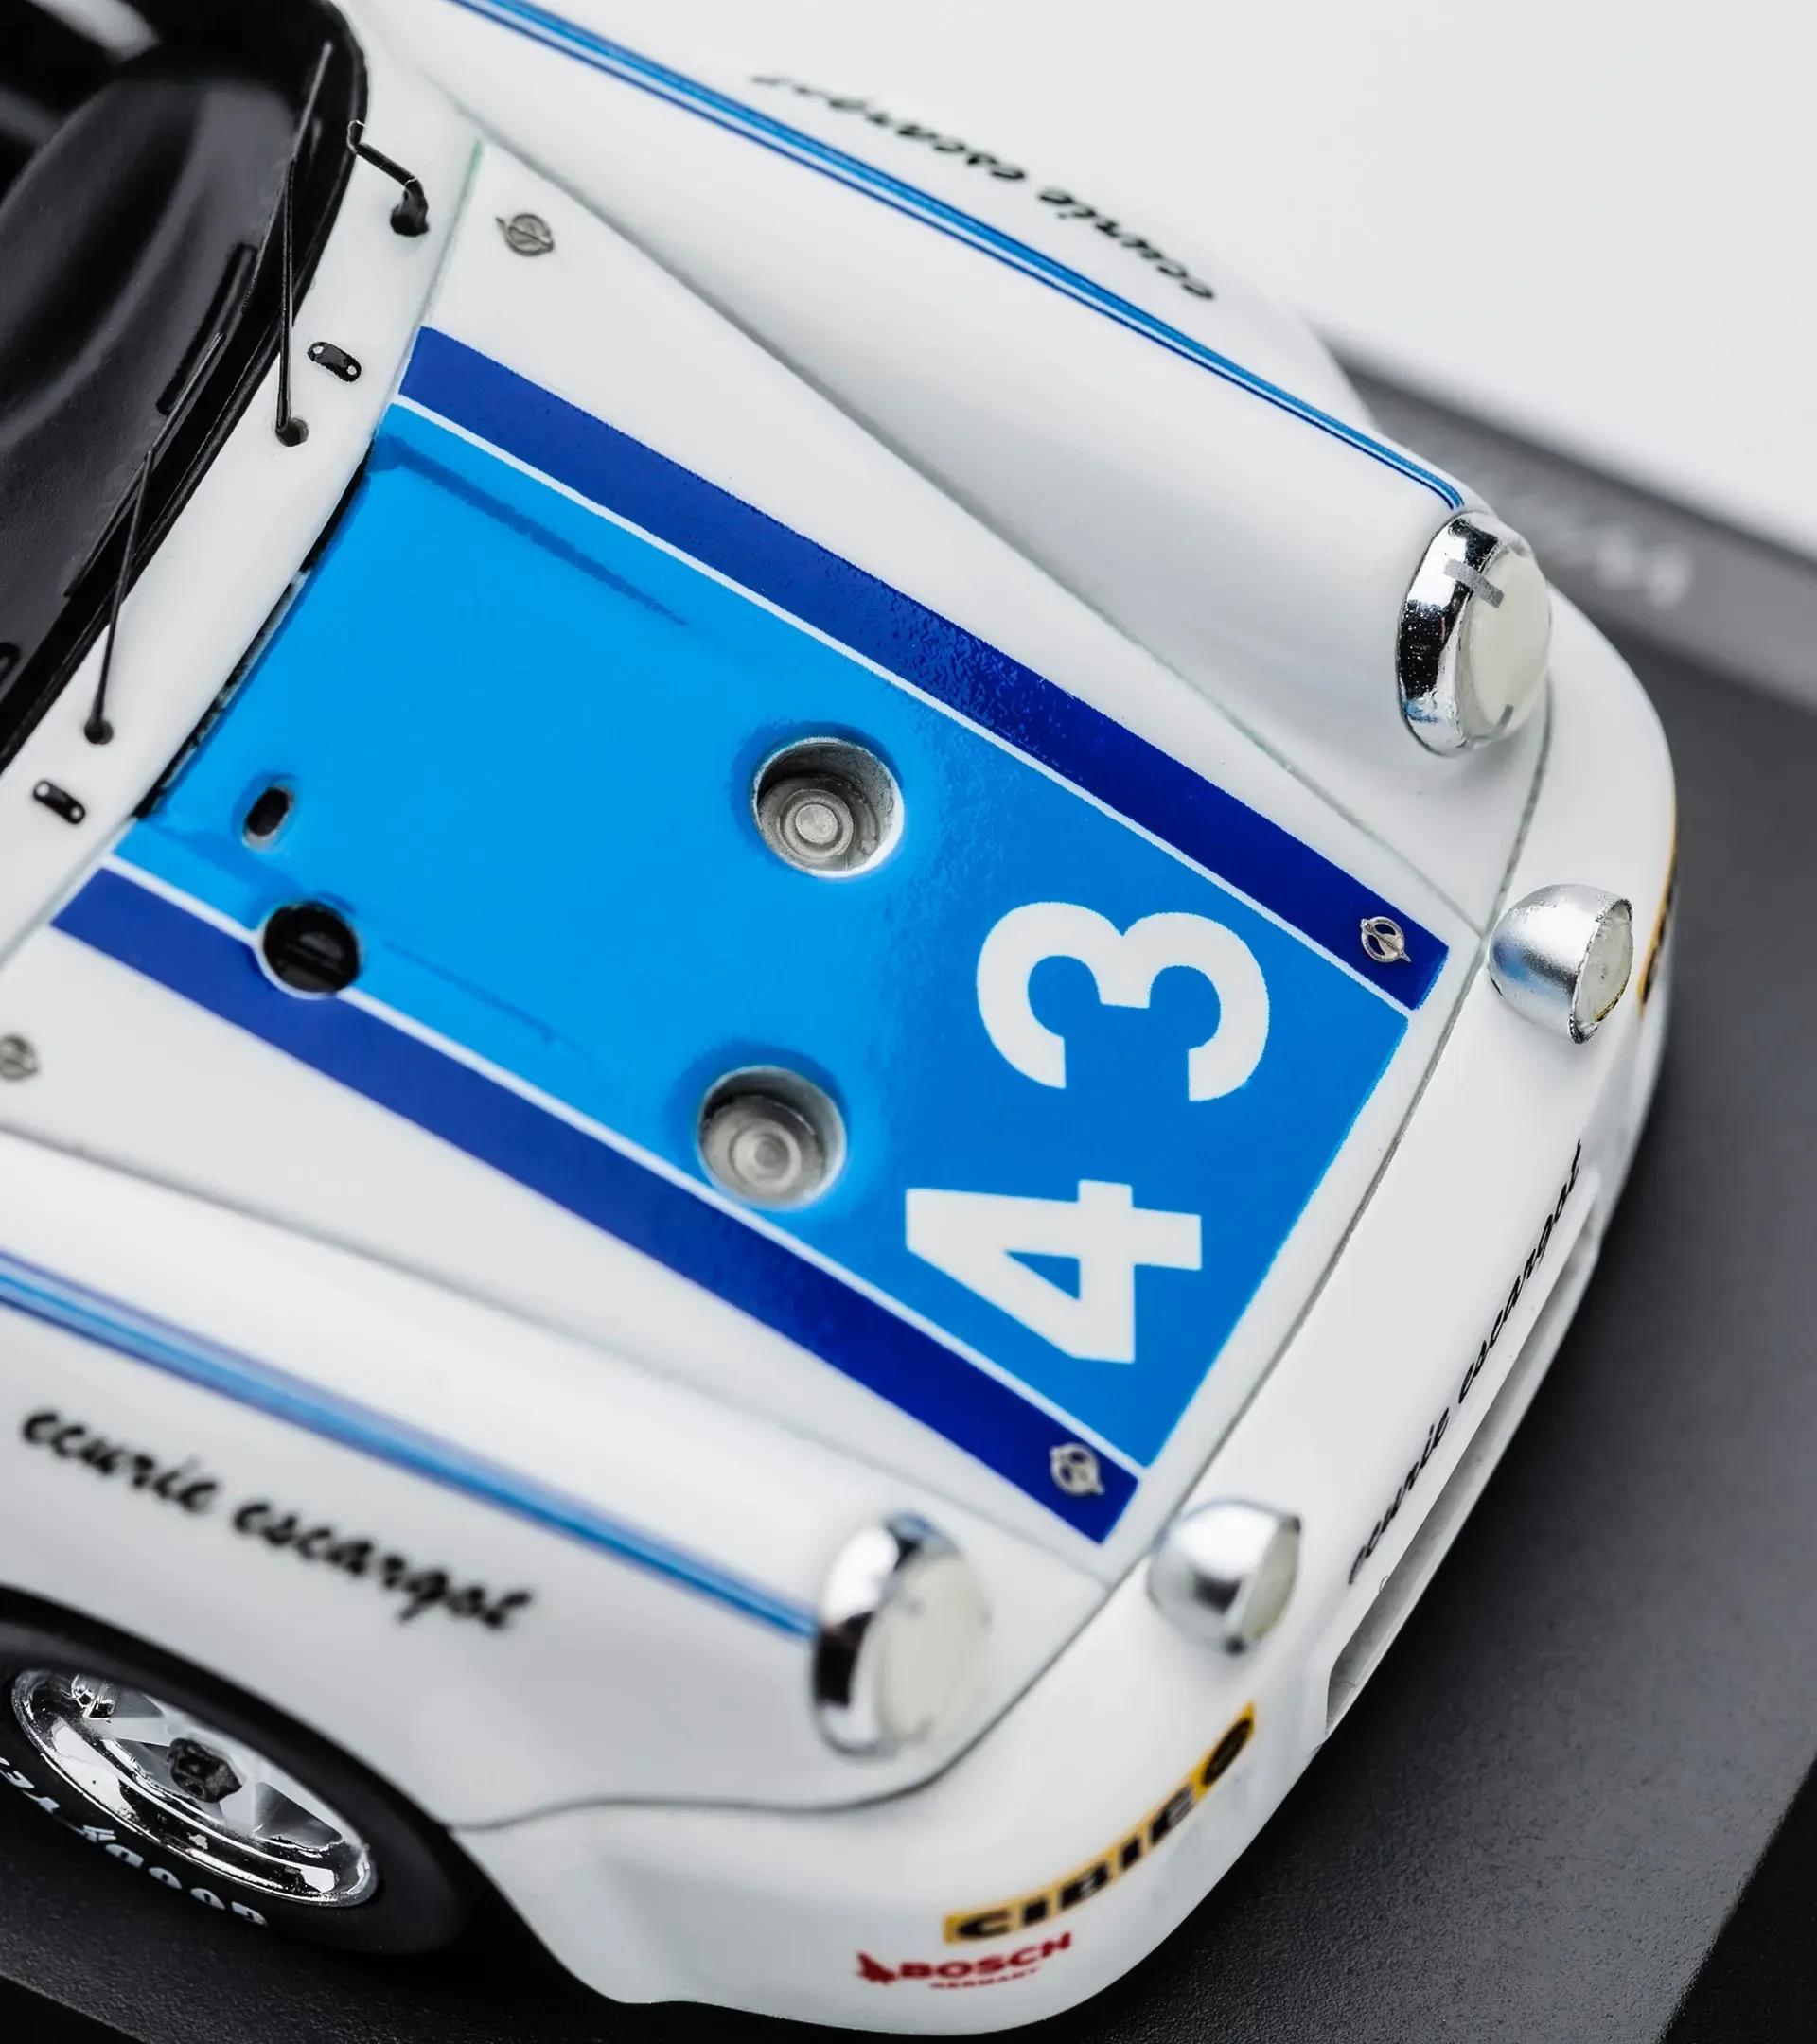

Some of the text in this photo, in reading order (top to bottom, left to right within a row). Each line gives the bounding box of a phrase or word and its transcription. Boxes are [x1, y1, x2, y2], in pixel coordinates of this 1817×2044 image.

[906, 902, 1270, 1364] 43
[1348, 1138, 1581, 1586] ecurie escargot
[898, 1931, 1073, 1980] BOSCH
